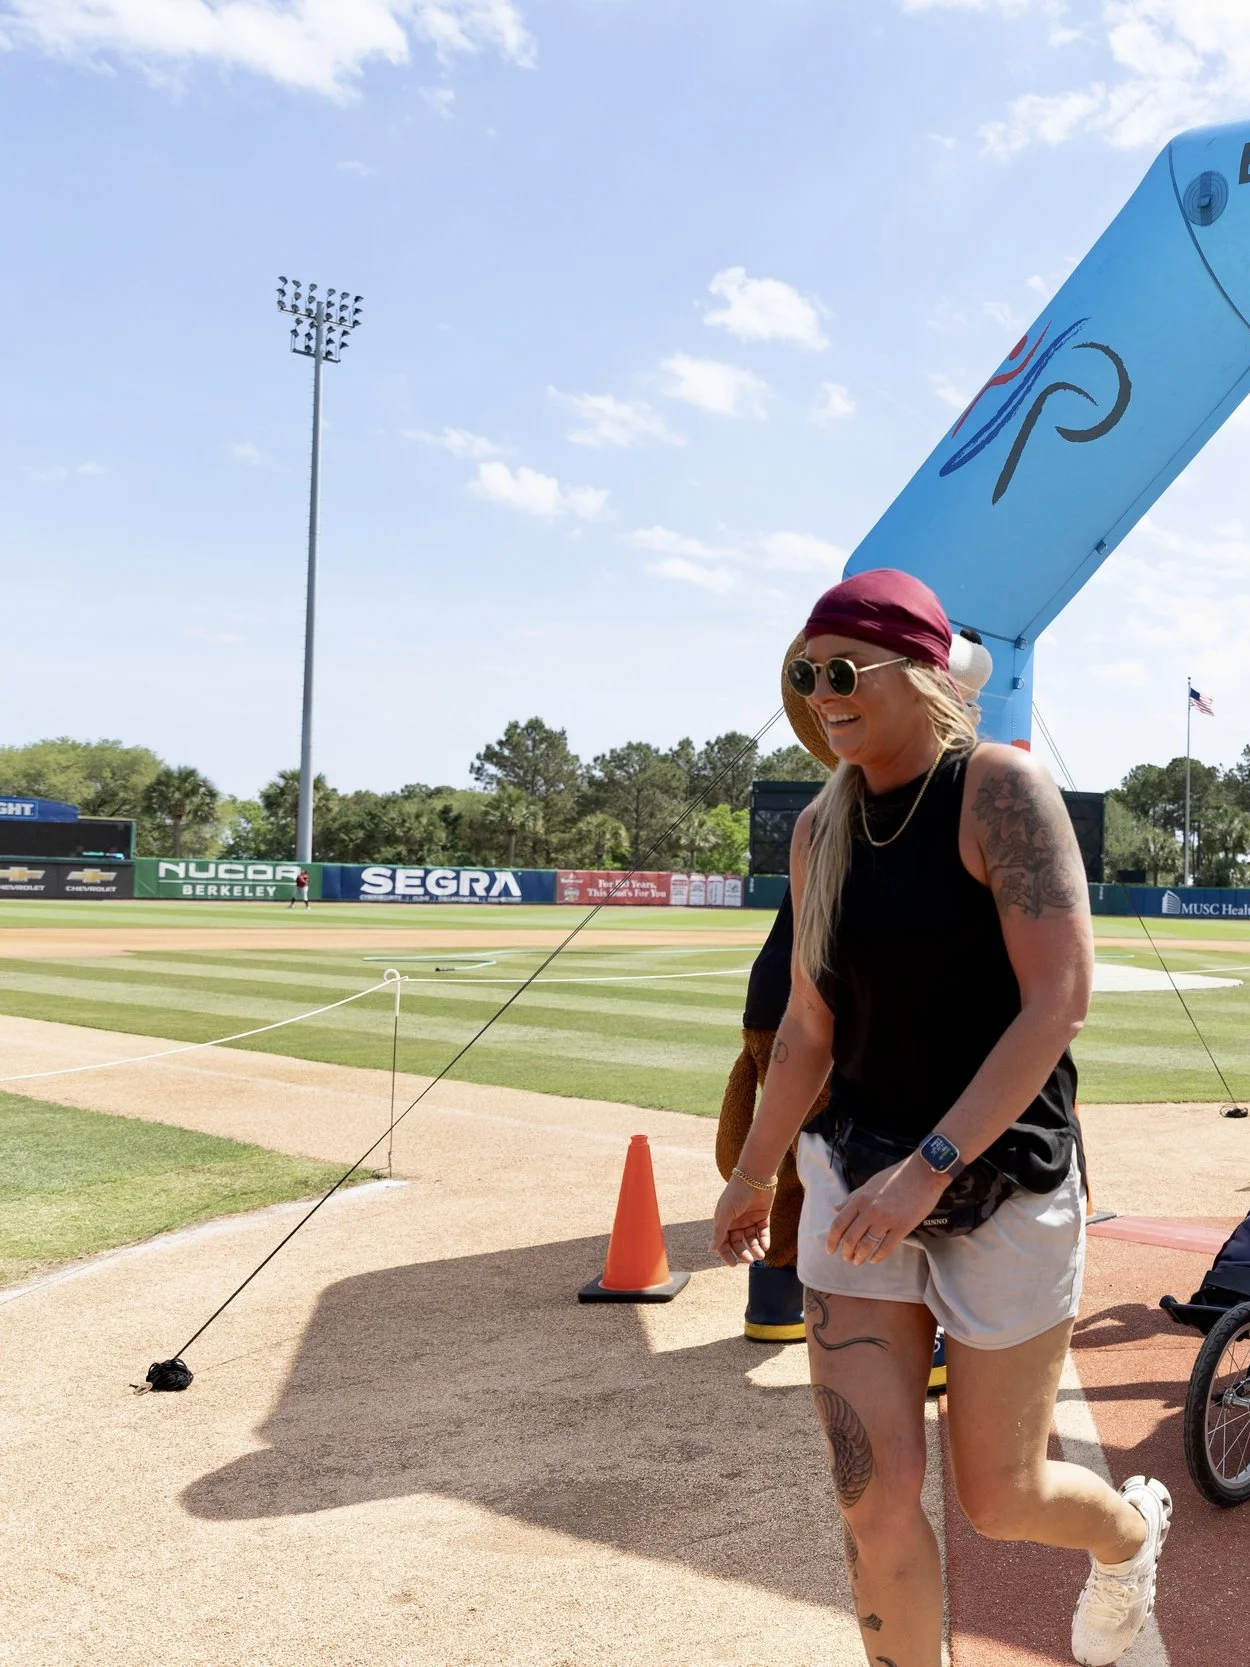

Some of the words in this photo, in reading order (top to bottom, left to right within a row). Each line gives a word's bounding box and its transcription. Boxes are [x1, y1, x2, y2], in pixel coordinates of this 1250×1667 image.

[158, 862, 301, 880] NUCOR
[360, 867, 522, 897] SEGRA
[598, 879, 613, 888] For
[182, 885, 277, 897] BERKELEY
[587, 888, 607, 896] This
[635, 889, 649, 897] For
[650, 889, 666, 897] You
[1181, 903, 1220, 915] MUSC
[923, 1218, 948, 1226] SINNO
